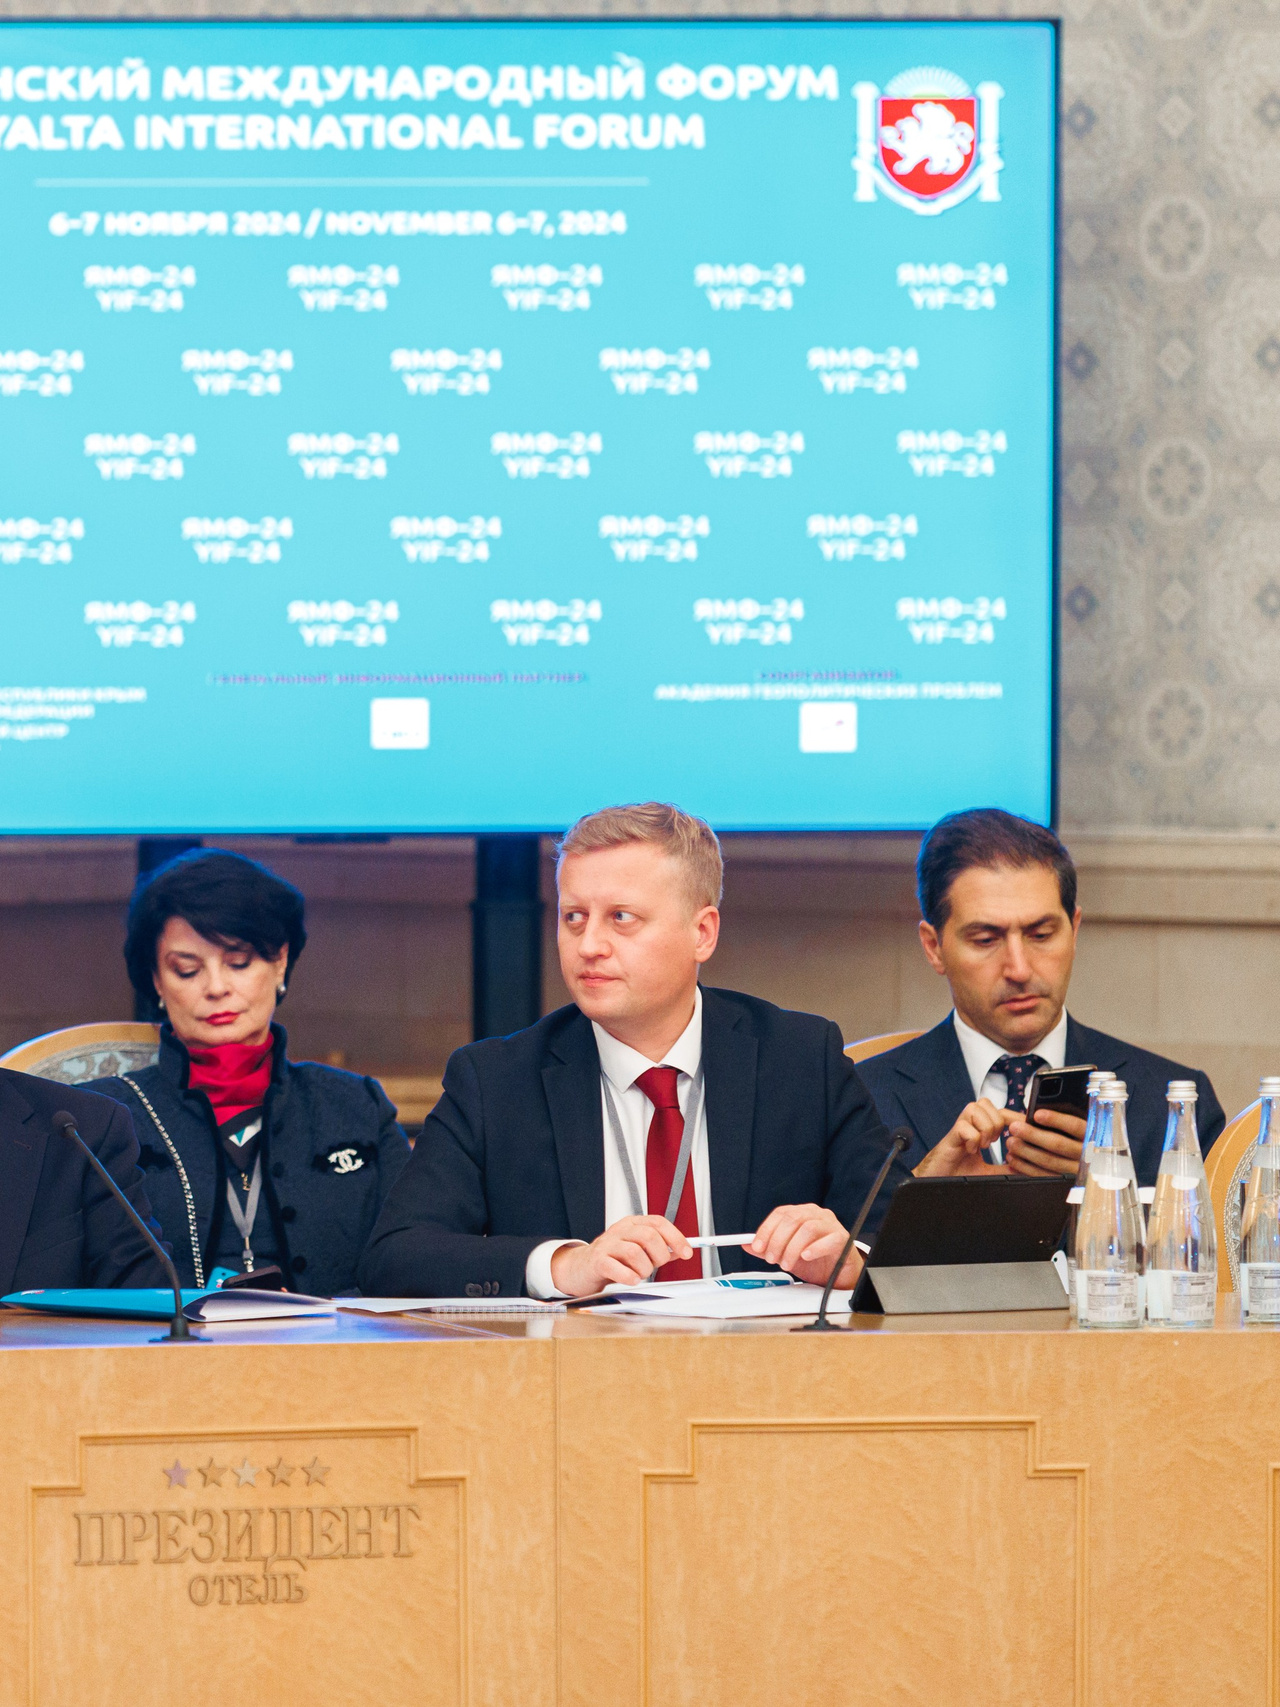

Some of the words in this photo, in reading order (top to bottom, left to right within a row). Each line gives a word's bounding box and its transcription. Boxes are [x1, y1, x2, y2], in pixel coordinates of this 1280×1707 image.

[162, 54, 645, 108] МЕЖДУНАРОДНЫЙ
[656, 64, 838, 100] ФОРУМ
[135, 114, 523, 149] INTERNATIONAL
[534, 114, 705, 149] FORUM
[104, 211, 228, 236] НОЯБРЯ
[231, 211, 302, 236] 2024
[326, 210, 493, 236] NOVEMBER
[559, 210, 627, 235] 2024
[73, 1504, 421, 1569] ПРЕЗИДЕНТ
[188, 1570, 309, 1606] ОТЕЛЬ
